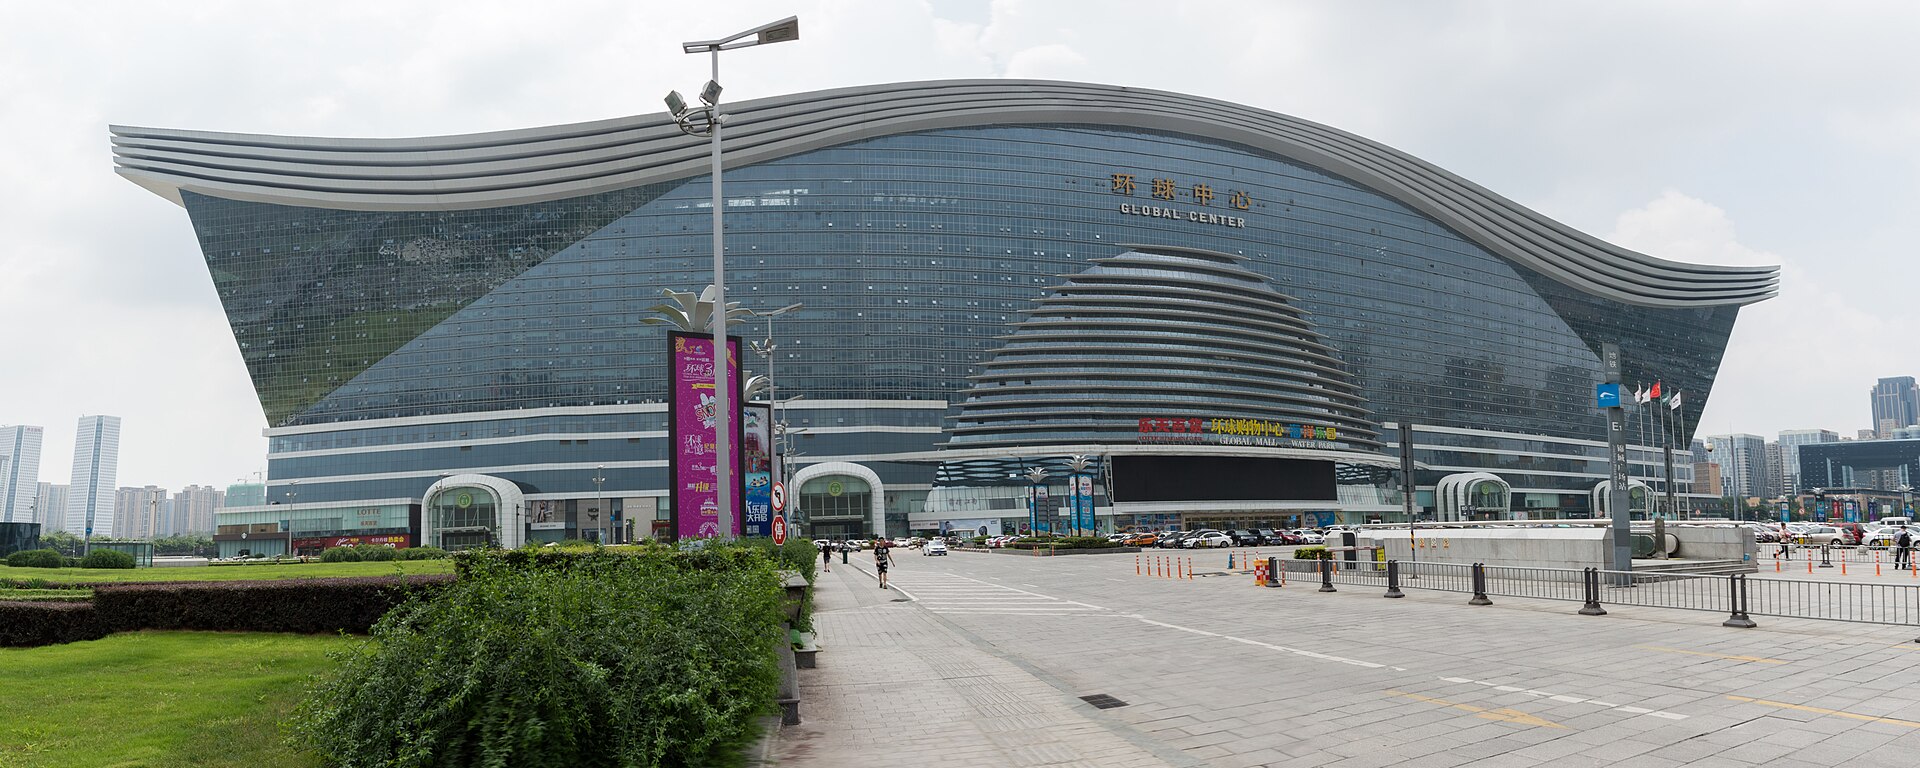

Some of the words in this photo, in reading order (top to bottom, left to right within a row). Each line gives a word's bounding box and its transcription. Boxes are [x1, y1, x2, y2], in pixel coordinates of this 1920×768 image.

[1111, 173, 1252, 210] 环球中心
[1120, 203, 1181, 219] GLOBAL
[1190, 212, 1246, 228] CENTER
[1608, 351, 1617, 368] 地铁
[1138, 417, 1203, 434] 乐天百货
[1211, 418, 1284, 436] 环球购物中心
[1289, 423, 1337, 440] 海洋乐园
[1612, 421, 1622, 431] E1
[1219, 436, 1252, 446] GLOBAL
[1256, 437, 1278, 446] MALL
[1291, 440, 1316, 448] WATER
[1318, 441, 1336, 449] PARK
[357, 508, 381, 516] LOTTE
[746, 513, 768, 522] 大开启
[774, 521, 784, 540] 停
